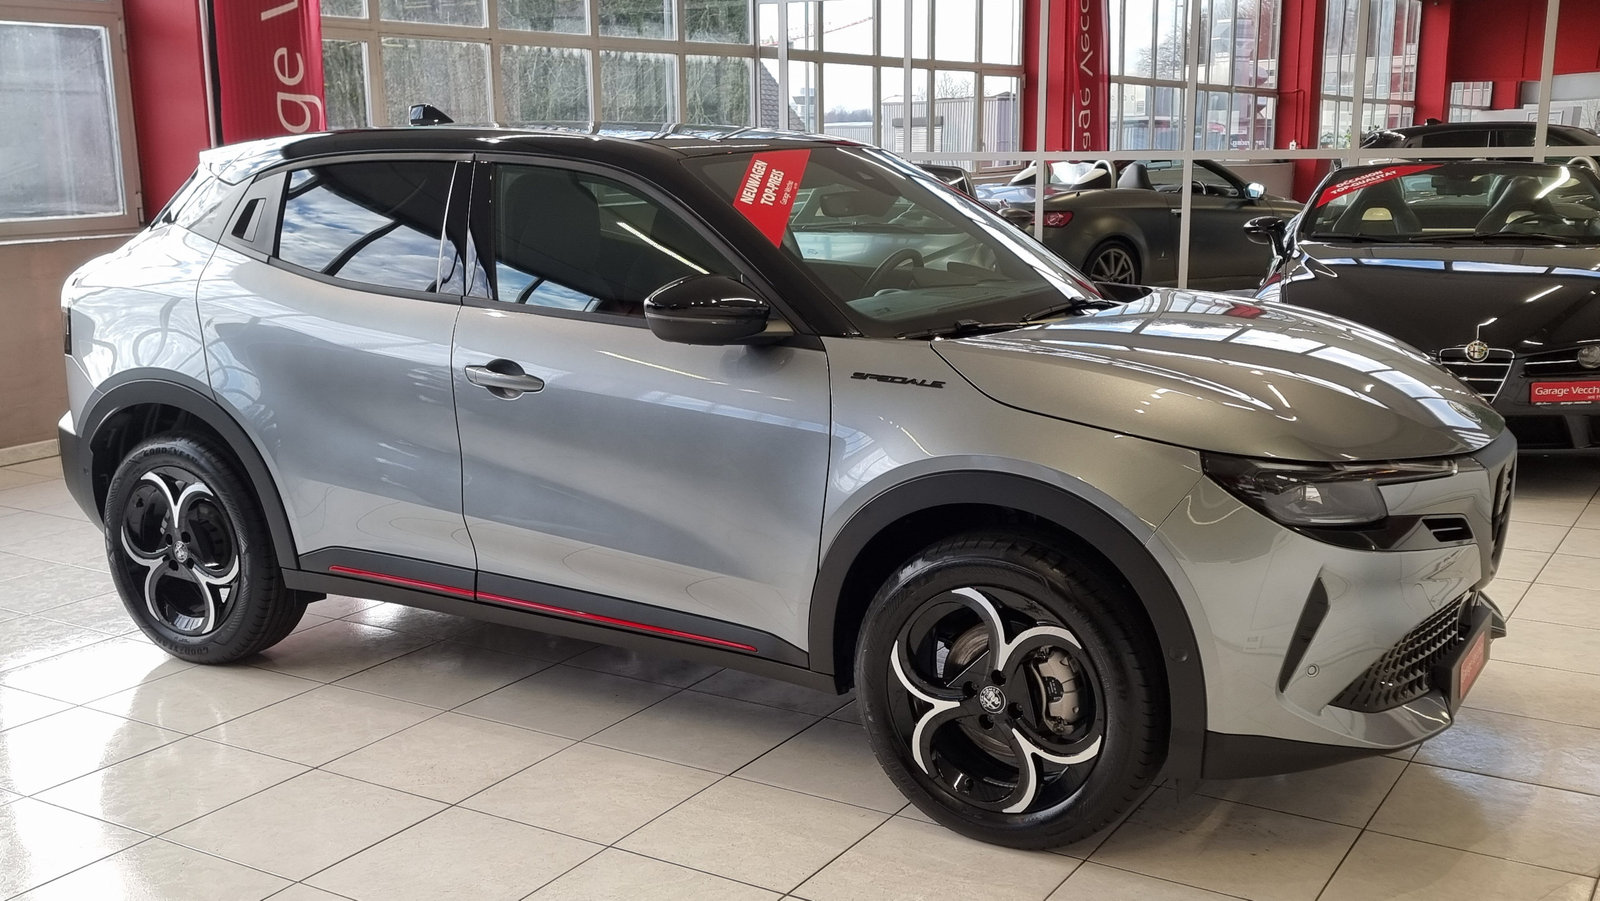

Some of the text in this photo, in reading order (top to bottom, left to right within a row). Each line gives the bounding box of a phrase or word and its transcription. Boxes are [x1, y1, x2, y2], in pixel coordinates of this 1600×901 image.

[740, 159, 768, 205] NEUWAGEN
[1336, 170, 1383, 188] OCCASION
[1535, 386, 1570, 398] Garage
